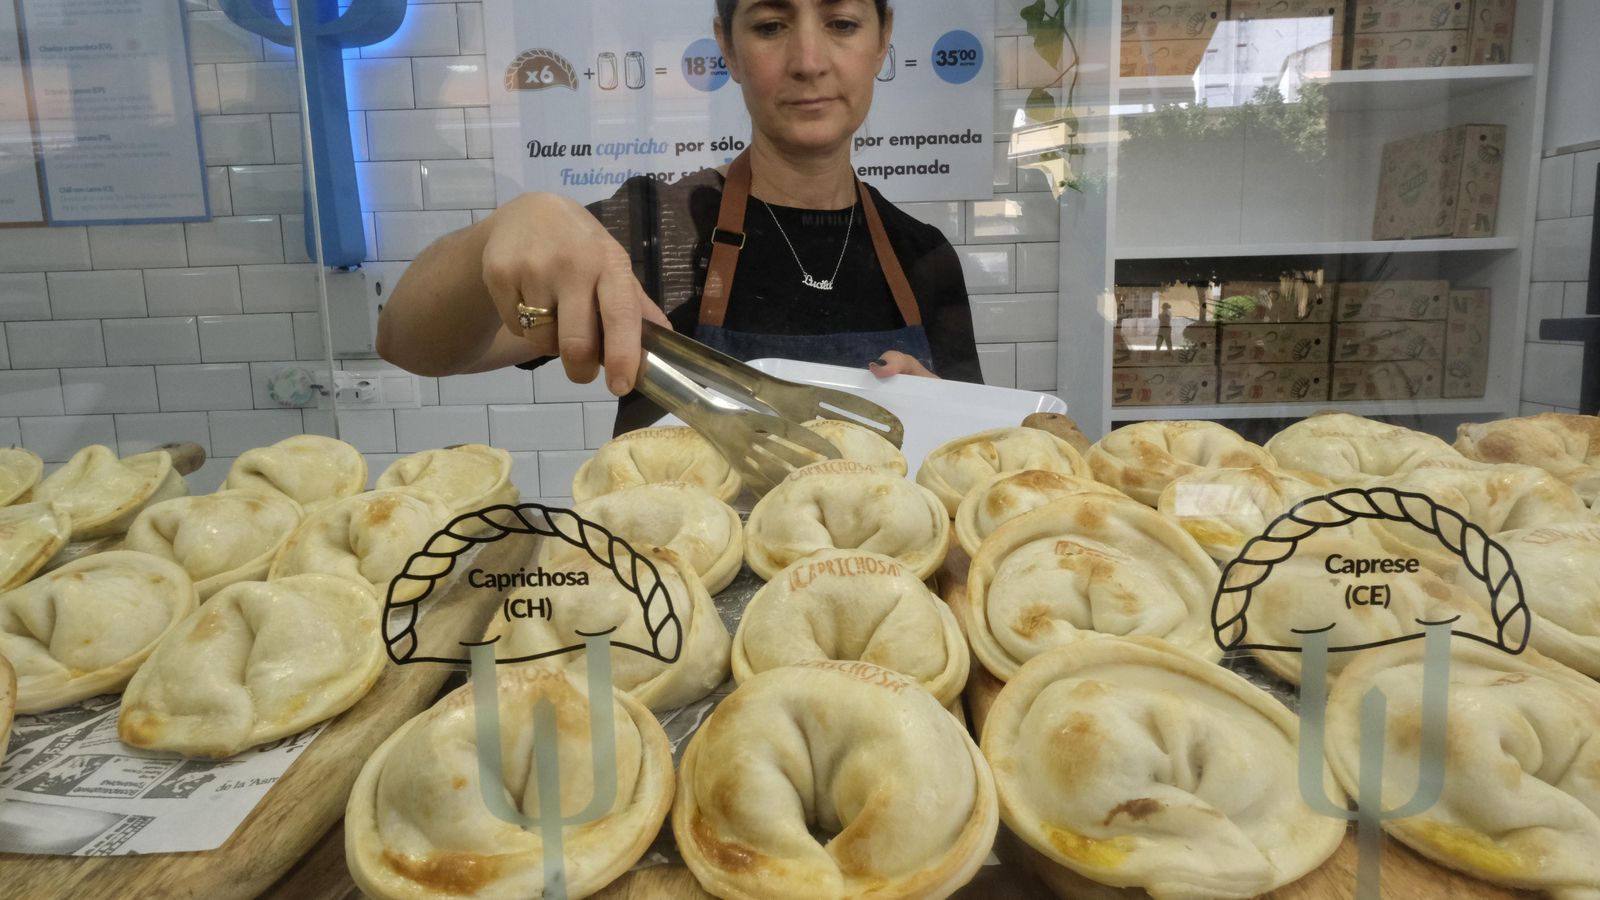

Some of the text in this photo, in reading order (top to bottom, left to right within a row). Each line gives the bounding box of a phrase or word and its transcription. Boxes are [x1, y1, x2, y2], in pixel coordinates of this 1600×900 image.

[525, 65, 555, 84] x6
[526, 128, 983, 160] Date un capricho por sólo por empanada
[857, 159, 950, 180] empanada
[789, 556, 901, 592] CAPRICHOSA
[1324, 553, 1420, 578] Caprese
[468, 566, 590, 592] Caprichosa
[1344, 583, 1391, 610] (CE)
[503, 597, 553, 622] (CH)
